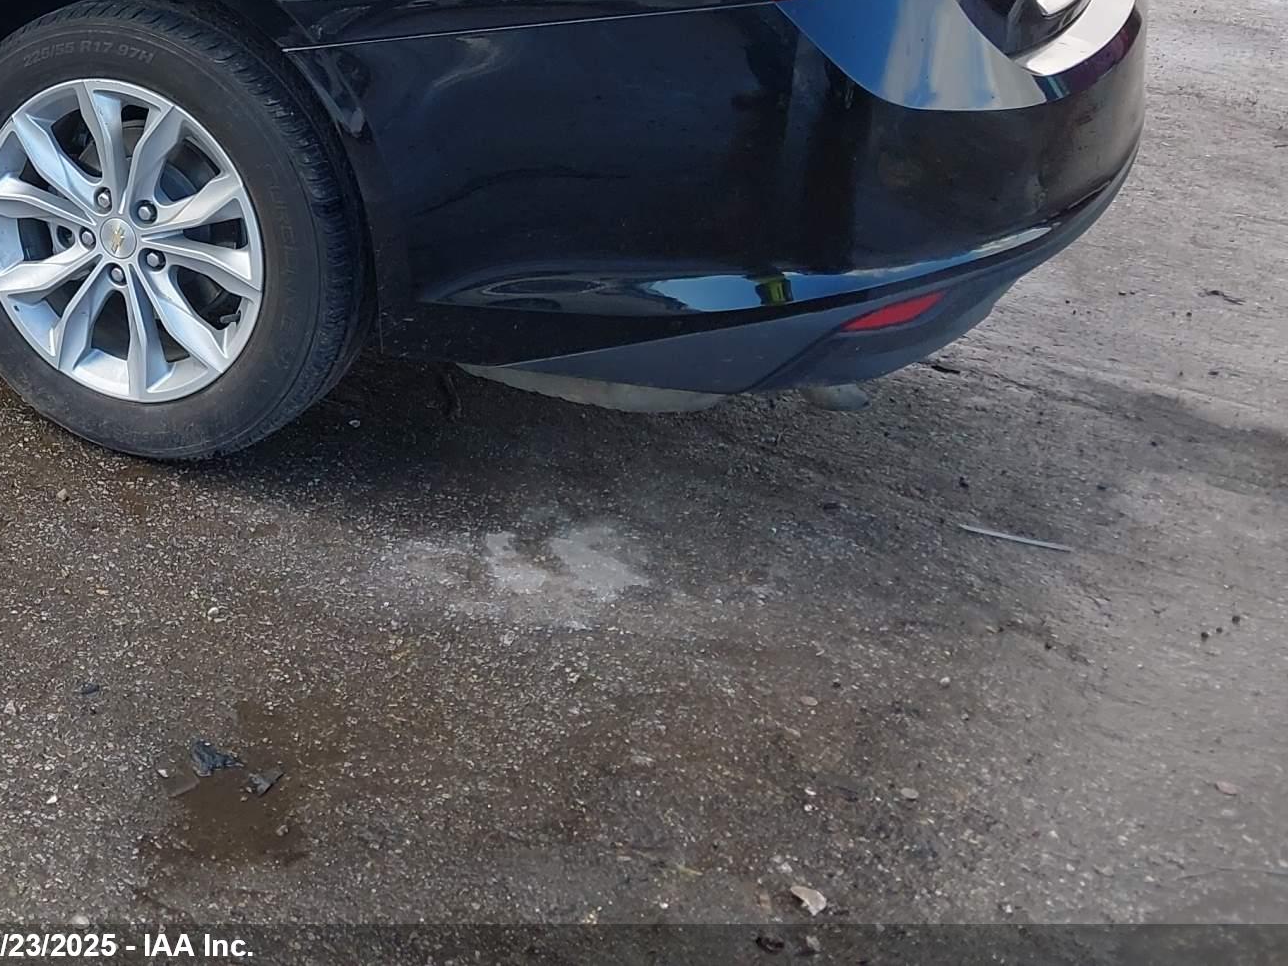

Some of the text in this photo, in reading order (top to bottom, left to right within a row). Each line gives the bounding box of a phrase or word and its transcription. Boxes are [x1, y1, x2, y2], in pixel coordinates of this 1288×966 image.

[23, 39, 155, 68] 225/55 R17 97H
